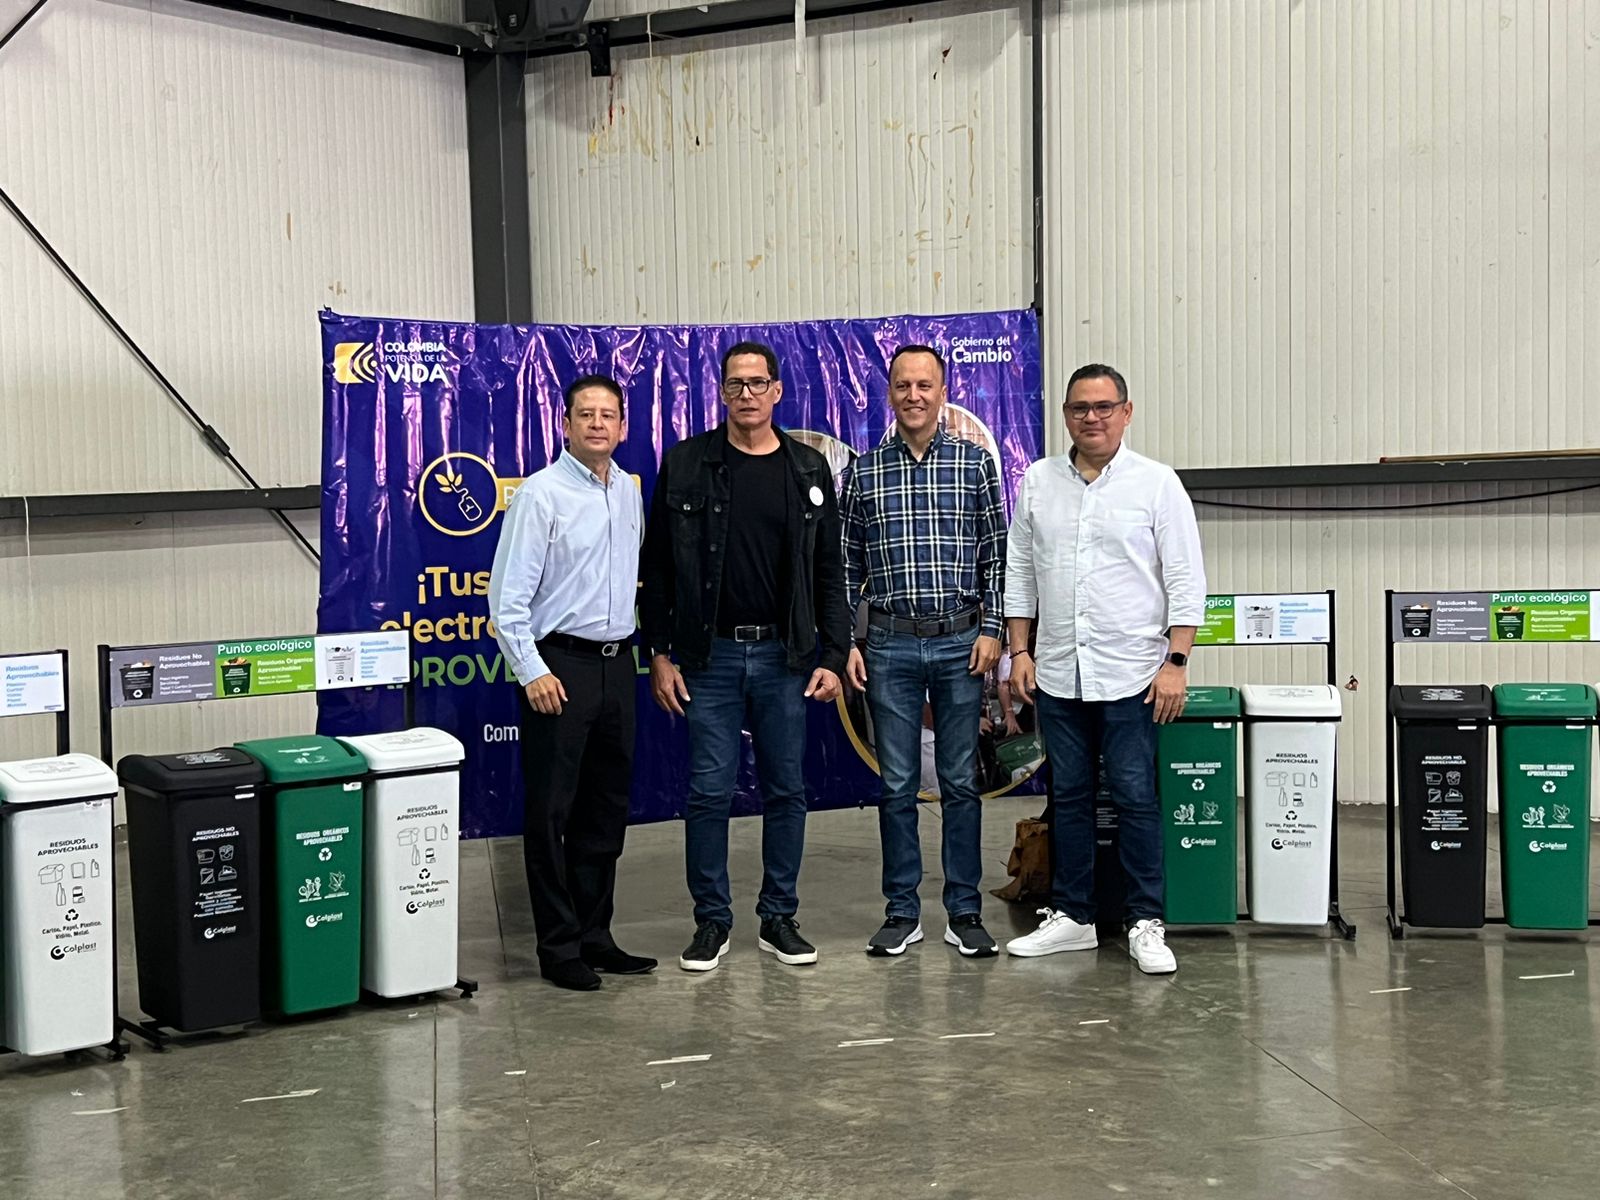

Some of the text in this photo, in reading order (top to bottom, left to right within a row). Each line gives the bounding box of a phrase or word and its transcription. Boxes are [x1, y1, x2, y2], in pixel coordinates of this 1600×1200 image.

[951, 335, 1011, 347] Gobierno del
[384, 341, 446, 353] COLOMBIA
[385, 353, 423, 363] POTENCIA
[424, 354, 435, 362] DE
[951, 346, 1012, 363] Cambio
[385, 363, 449, 384] VIDA
[1492, 593, 1587, 604] Punto ecológico
[217, 640, 312, 655] Punto ecológico
[407, 804, 438, 813] RESIDUOS
[397, 809, 449, 821] APROVECHABLES
[50, 838, 86, 847] RESIDUOS
[1190, 838, 1217, 846] Colplast
[1282, 840, 1312, 848] Colplast
[1539, 842, 1567, 850] Colplast
[37, 843, 99, 857] APROVECHABLES
[416, 898, 445, 909] Colplast
[316, 912, 343, 923] Colplast
[63, 942, 97, 954] Colplast
